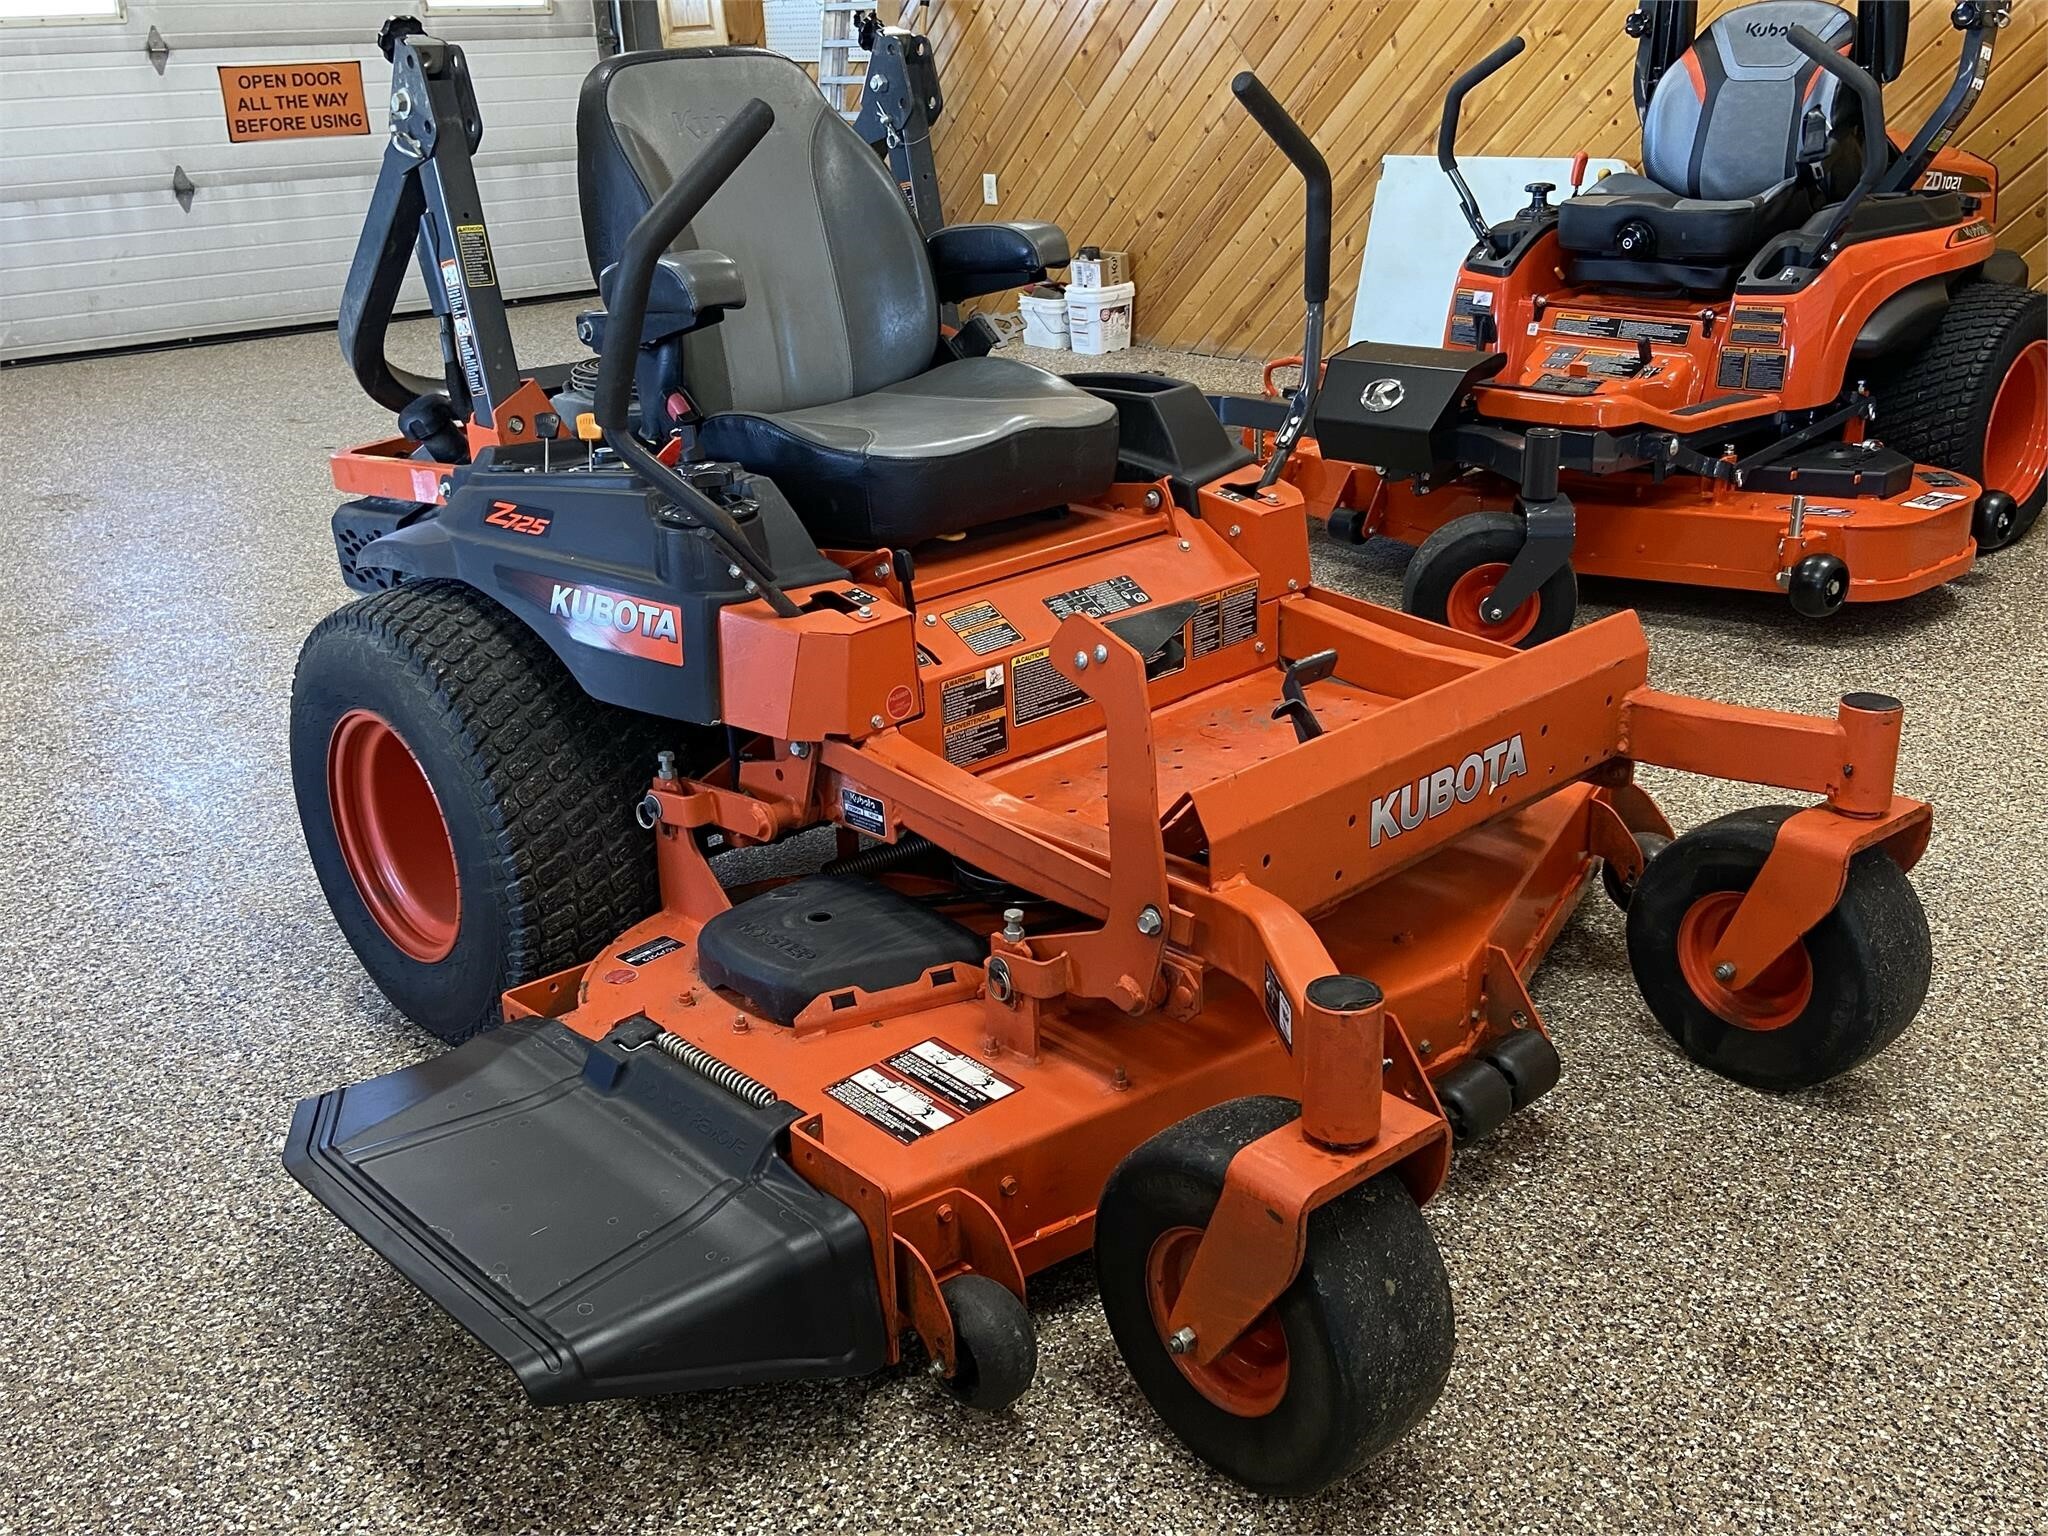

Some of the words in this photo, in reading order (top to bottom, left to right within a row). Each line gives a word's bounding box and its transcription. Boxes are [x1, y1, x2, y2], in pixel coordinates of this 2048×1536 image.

[1746, 22, 1796, 38] Kubo
[238, 73, 287, 89] OPEN
[292, 71, 342, 87] DOOR
[237, 97, 272, 112] ALL
[274, 94, 310, 110] THE
[312, 92, 349, 108] WAY
[235, 116, 307, 134] BEFORE
[311, 113, 362, 129] USING
[485, 501, 551, 536] Z725
[549, 584, 678, 643] KUBOTA
[1020, 651, 1044, 663] CAUTION
[948, 673, 976, 689] WARNING
[951, 714, 991, 731] ADVERTENCIA
[1369, 732, 1528, 848] KUBOTA
[962, 1055, 994, 1075] DANGER
[901, 1082, 934, 1104] PELIGRO
